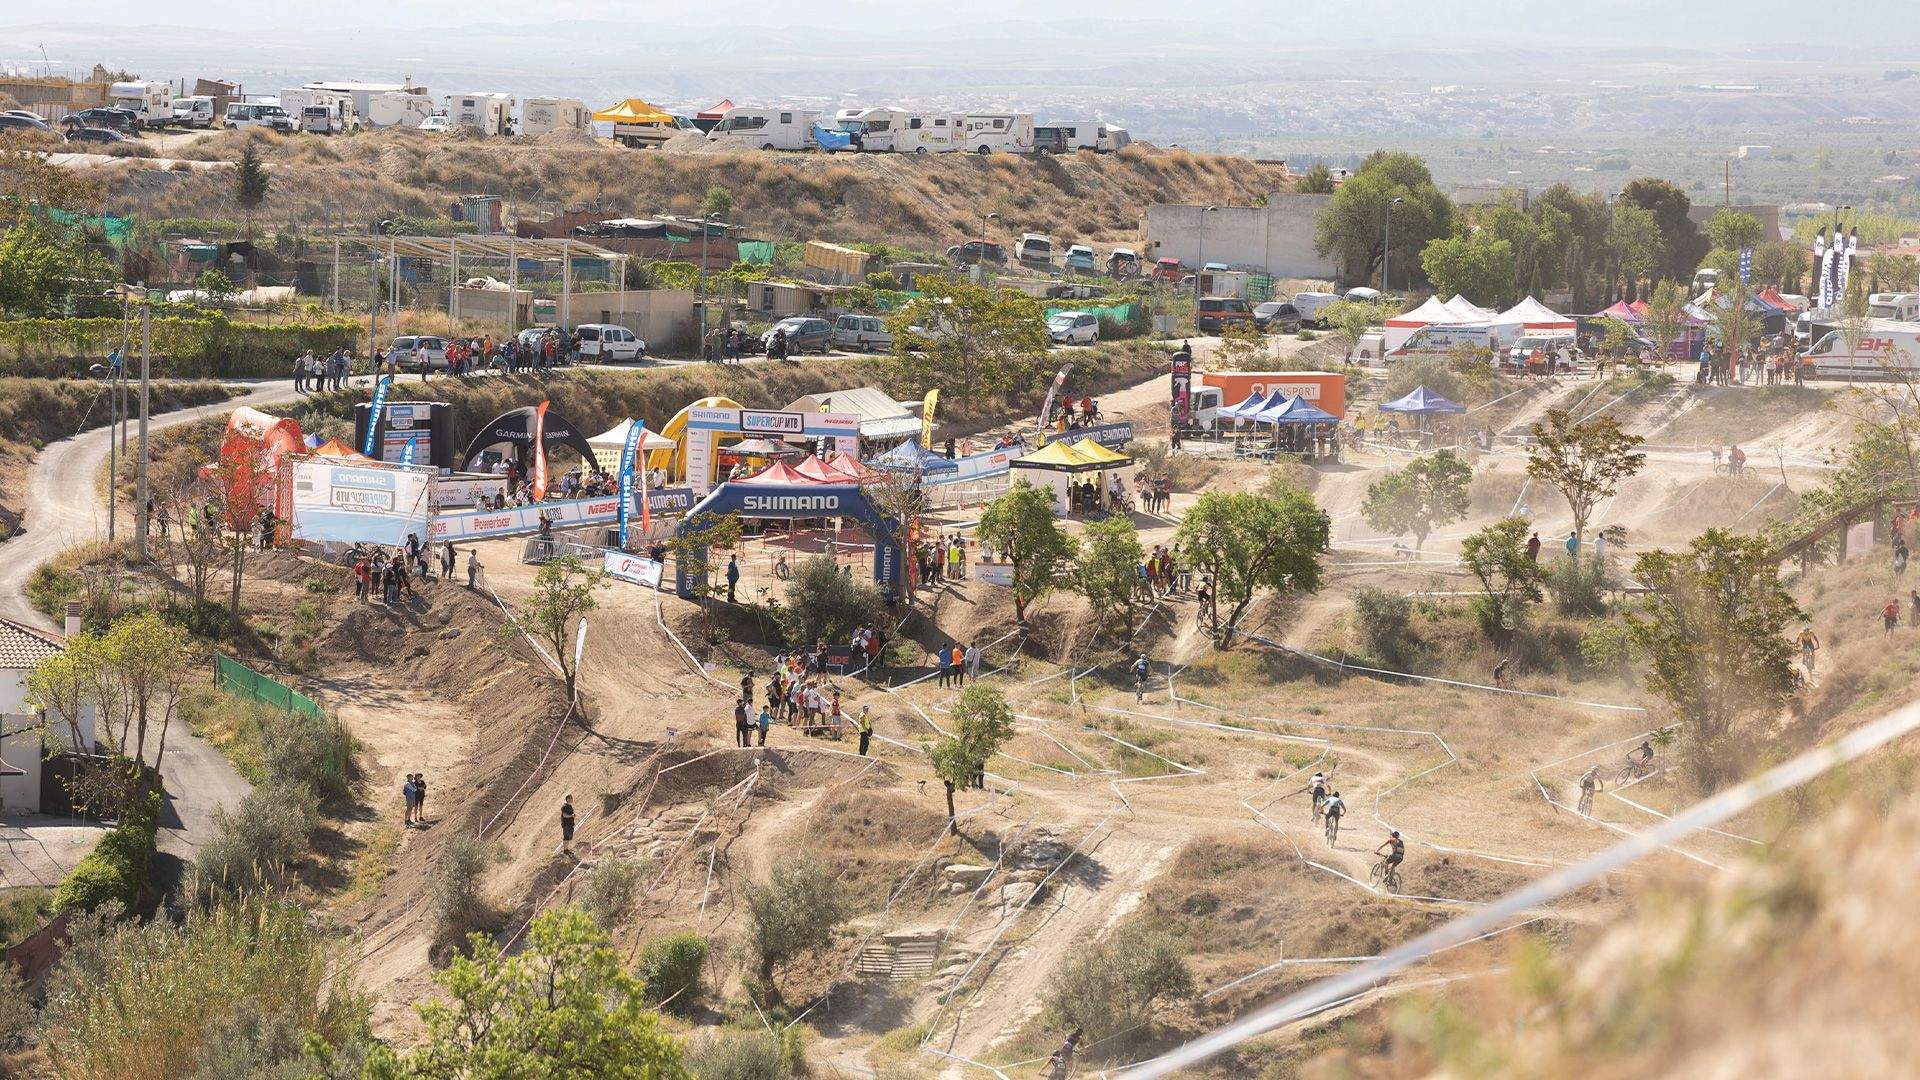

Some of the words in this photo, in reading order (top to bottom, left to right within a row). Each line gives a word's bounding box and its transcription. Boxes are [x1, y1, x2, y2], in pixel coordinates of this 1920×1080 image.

[1857, 338, 1894, 351] BH
[692, 411, 730, 420] SHIMANO
[746, 415, 785, 428] SUPERCUP
[785, 416, 798, 429] MTB
[495, 429, 532, 439] GARMIN
[1102, 427, 1132, 441] SHIMANO
[645, 494, 688, 511] HIMANO
[744, 496, 839, 510] SHIMANO
